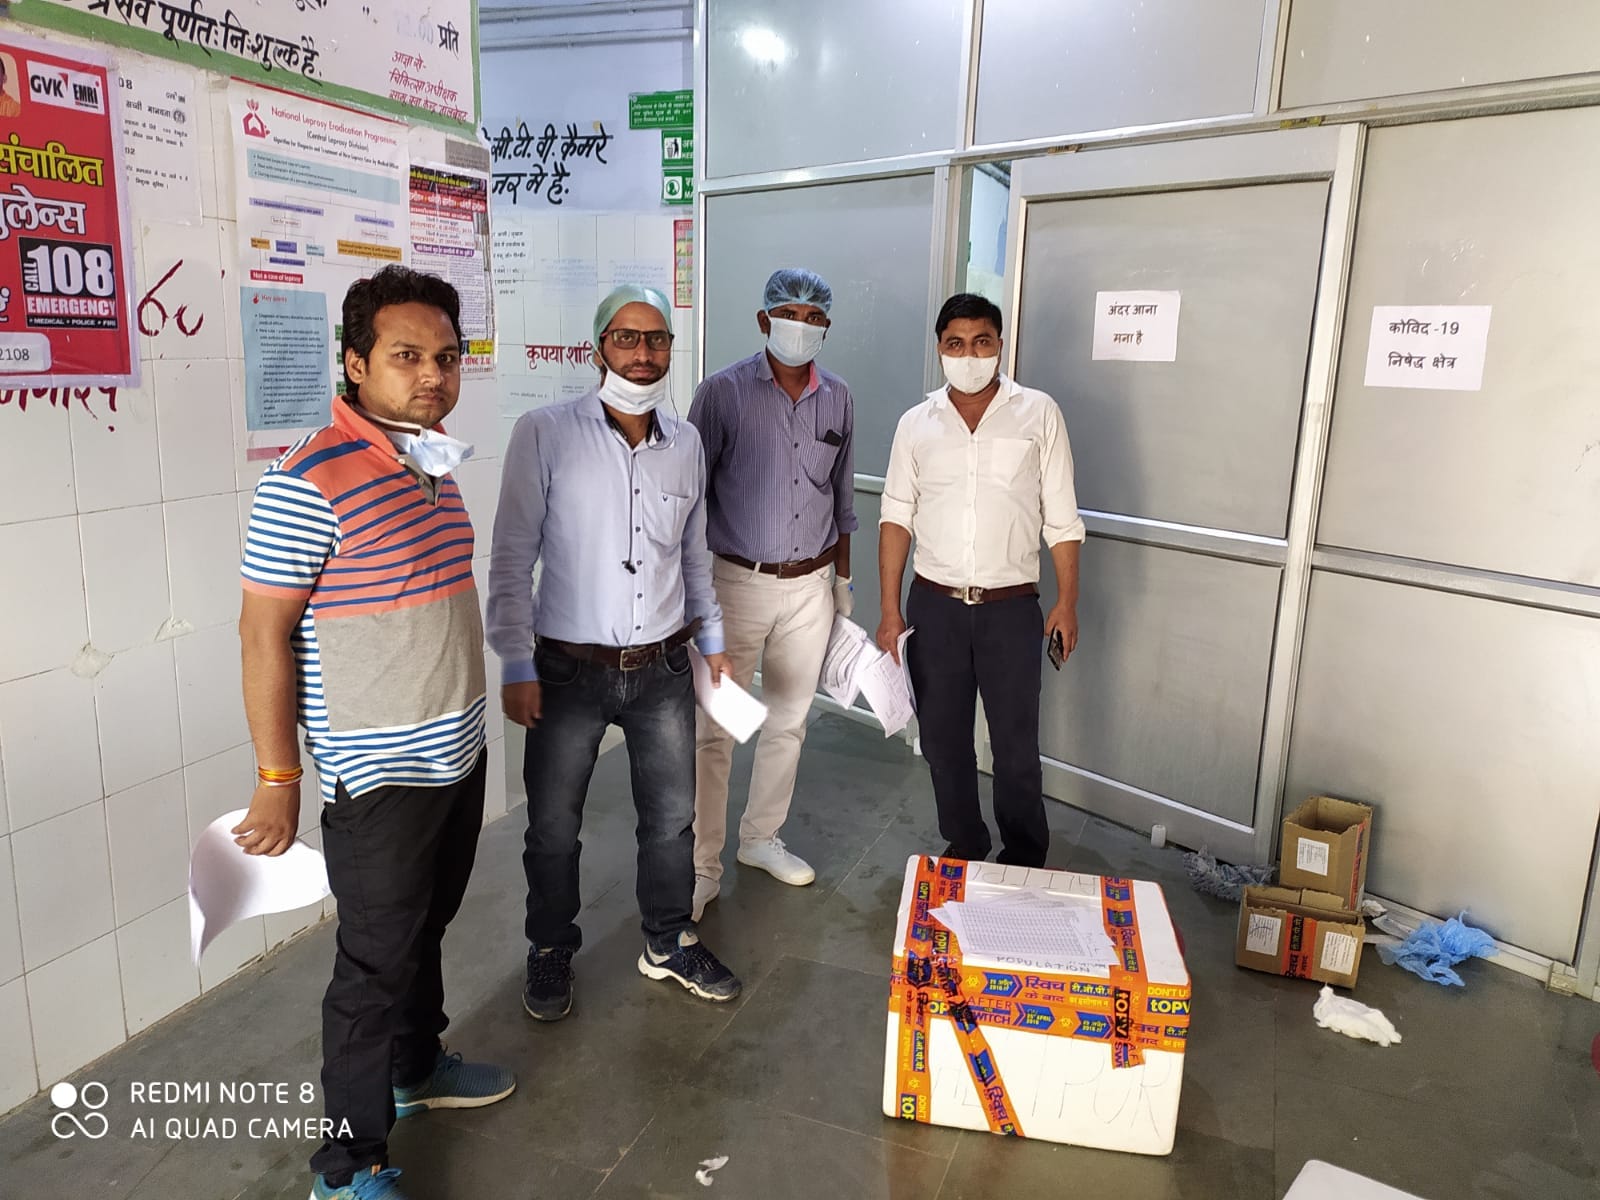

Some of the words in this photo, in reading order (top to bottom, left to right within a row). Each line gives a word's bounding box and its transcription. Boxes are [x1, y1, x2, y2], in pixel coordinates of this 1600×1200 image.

[30, 73, 65, 98] GVK
[73, 81, 99, 105] EMRI
[119, 77, 132, 90] 08
[271, 107, 301, 122] National
[302, 113, 328, 130] Leprosy
[328, 120, 362, 138] Eradication
[561, 122, 614, 164] कैमरे
[24, 262, 39, 292] CALL
[28, 245, 114, 297] 108
[27, 297, 116, 316] EMERGENCY
[1108, 301, 1131, 316] अंदर
[1132, 304, 1158, 316] आना
[34, 318, 64, 326] MEDICAL
[1389, 318, 1432, 336] कोविद
[1113, 333, 1134, 344] मना
[1136, 329, 1144, 345] है
[525, 344, 566, 370] कृपया
[1432, 353, 1458, 369] क्षेत्र
[996, 956, 1090, 973] POPULATION
[1025, 975, 1067, 991] स्विच
[1071, 982, 1111, 996] टी.ओ.पी.
[967, 996, 1012, 1009] AFTER
[1042, 994, 1064, 1002] बाद
